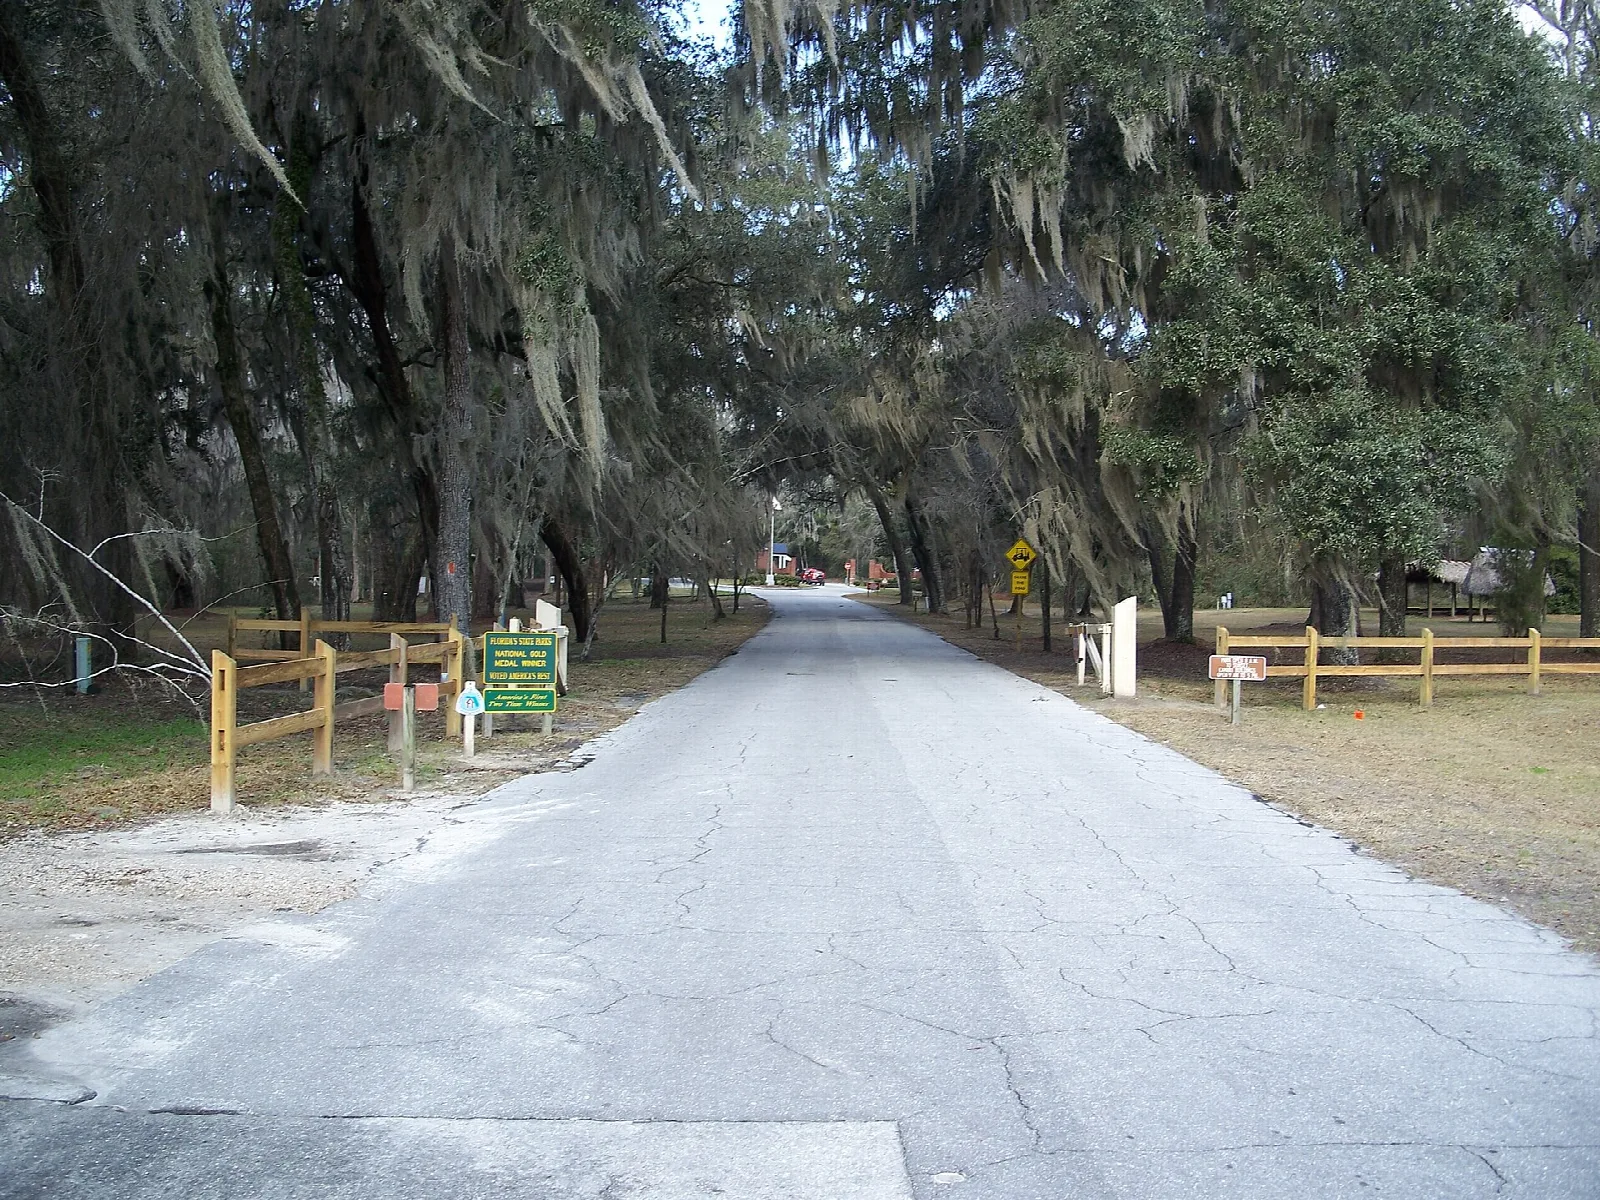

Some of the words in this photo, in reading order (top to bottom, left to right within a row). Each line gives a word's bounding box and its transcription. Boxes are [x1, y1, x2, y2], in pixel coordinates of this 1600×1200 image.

[490, 637, 518, 645] FLORIDA'S
[518, 637, 535, 646] STATE
[535, 637, 552, 646] PARKS
[494, 650, 527, 658] NATIONAL
[530, 650, 547, 658] GOLD
[490, 672, 508, 680] VOTED
